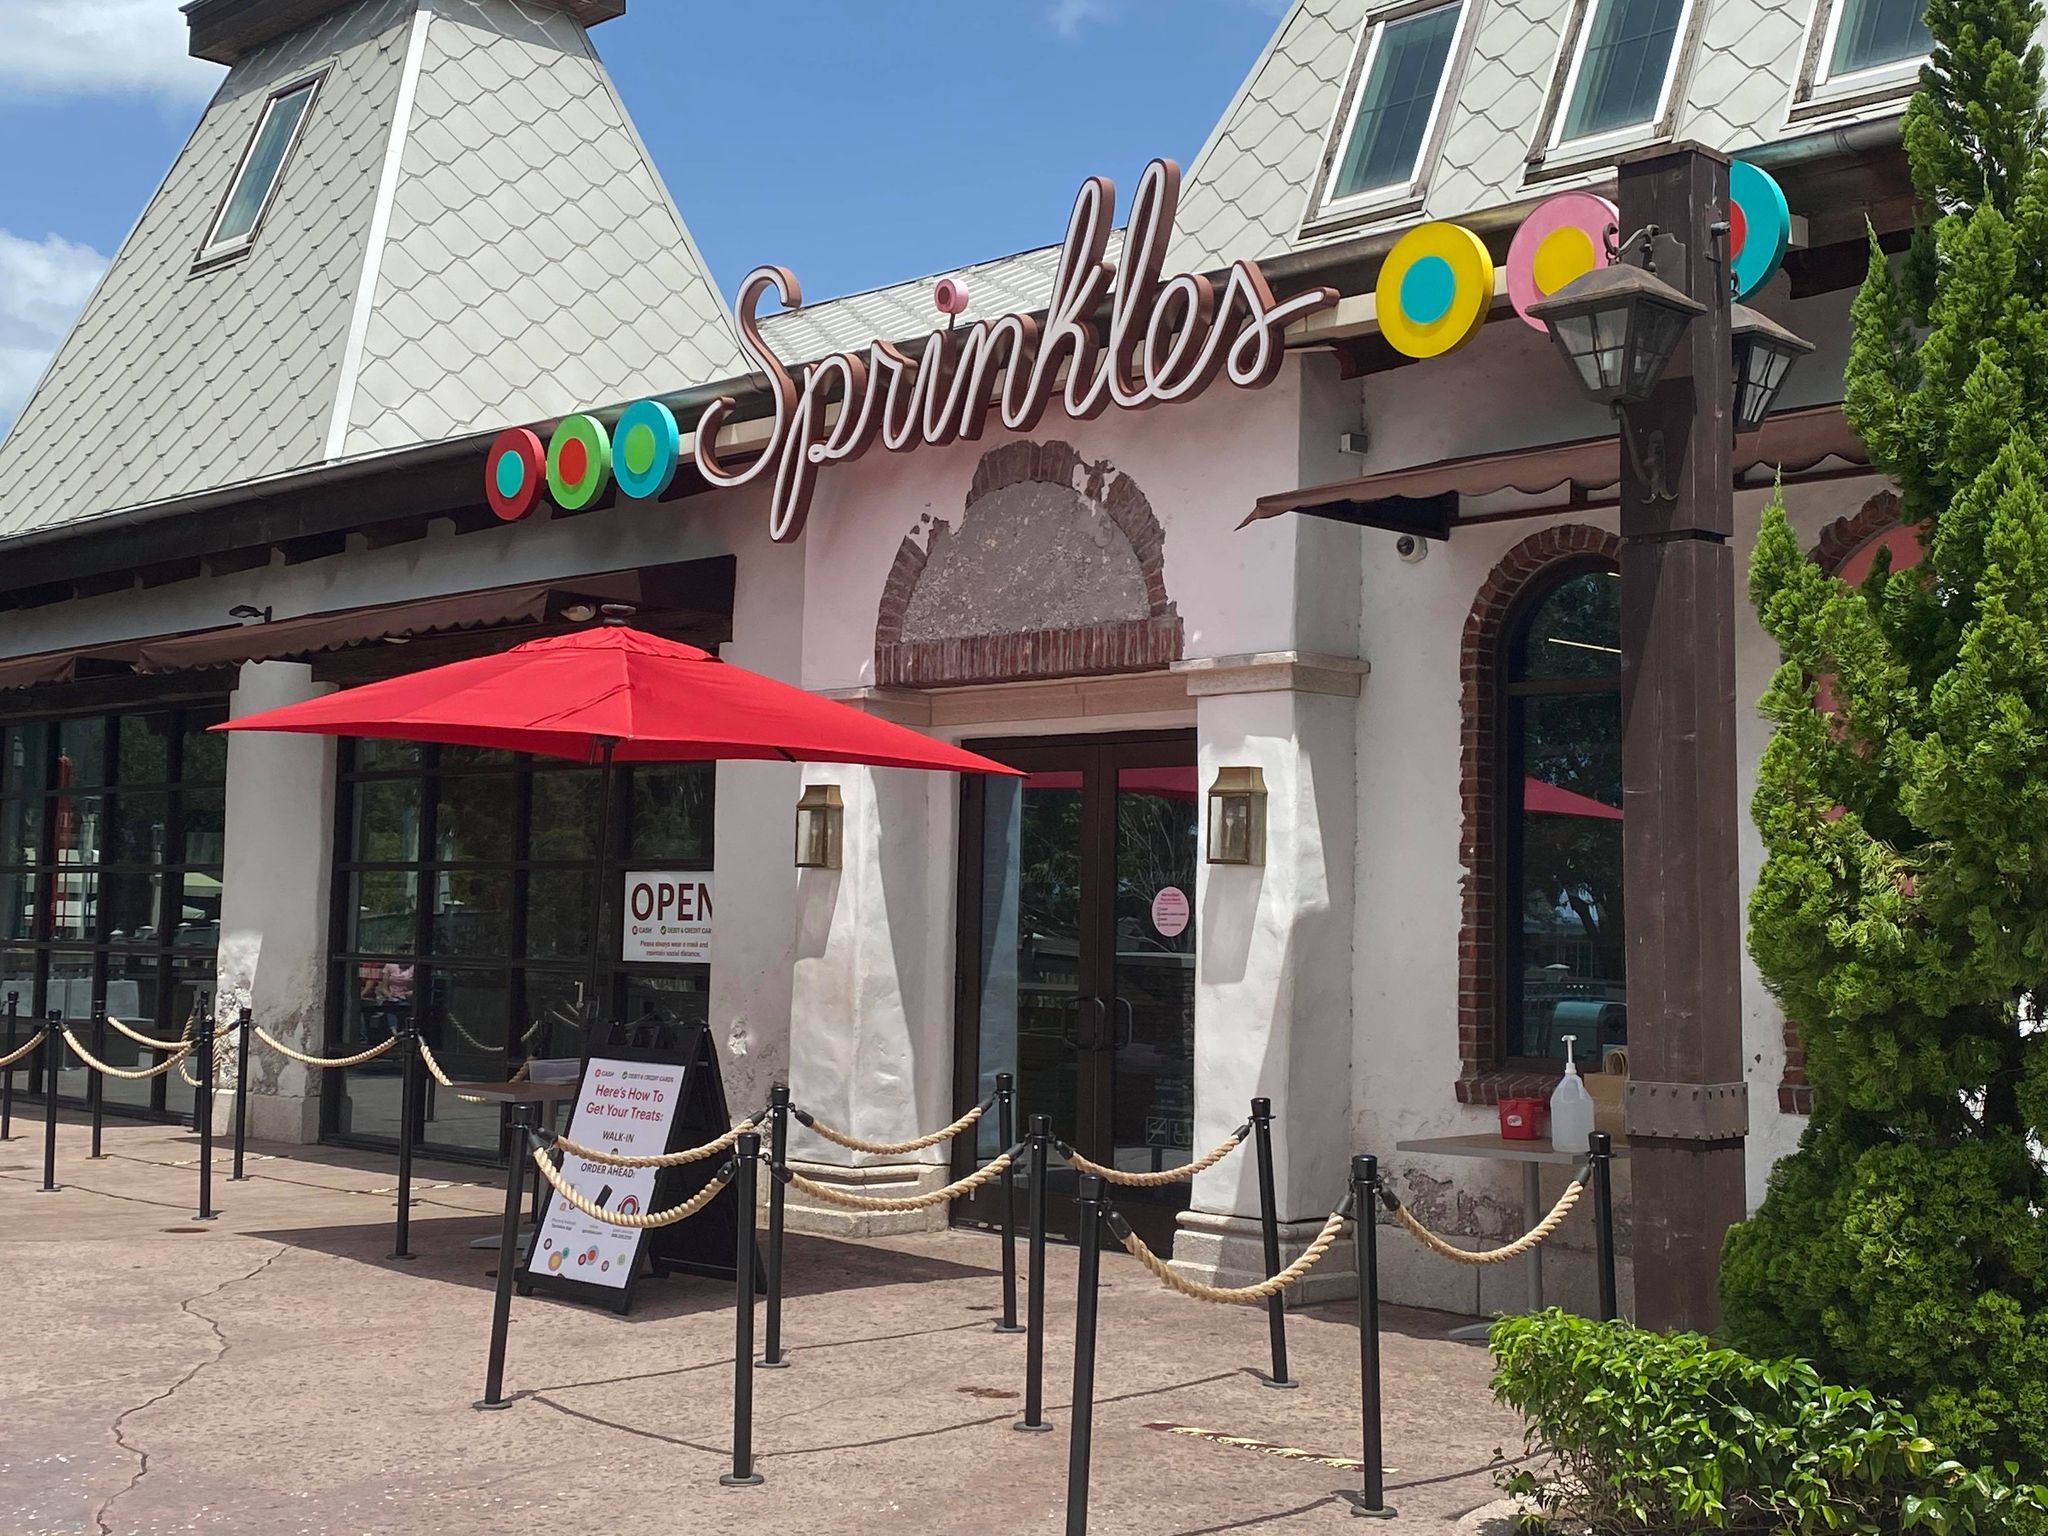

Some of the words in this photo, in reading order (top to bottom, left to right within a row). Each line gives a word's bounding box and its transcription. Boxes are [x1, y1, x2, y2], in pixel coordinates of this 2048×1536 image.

[695, 158, 1340, 544] Sprinkles
[631, 883, 713, 921] OPEN
[595, 1084, 626, 1099] Here's
[627, 1087, 651, 1102] How
[653, 1089, 664, 1103] To
[586, 1102, 604, 1115] Get
[607, 1104, 629, 1118] Your
[631, 1106, 664, 1122] Treats:
[602, 1130, 635, 1143] WALK-IN
[581, 1162, 607, 1174] ORDER
